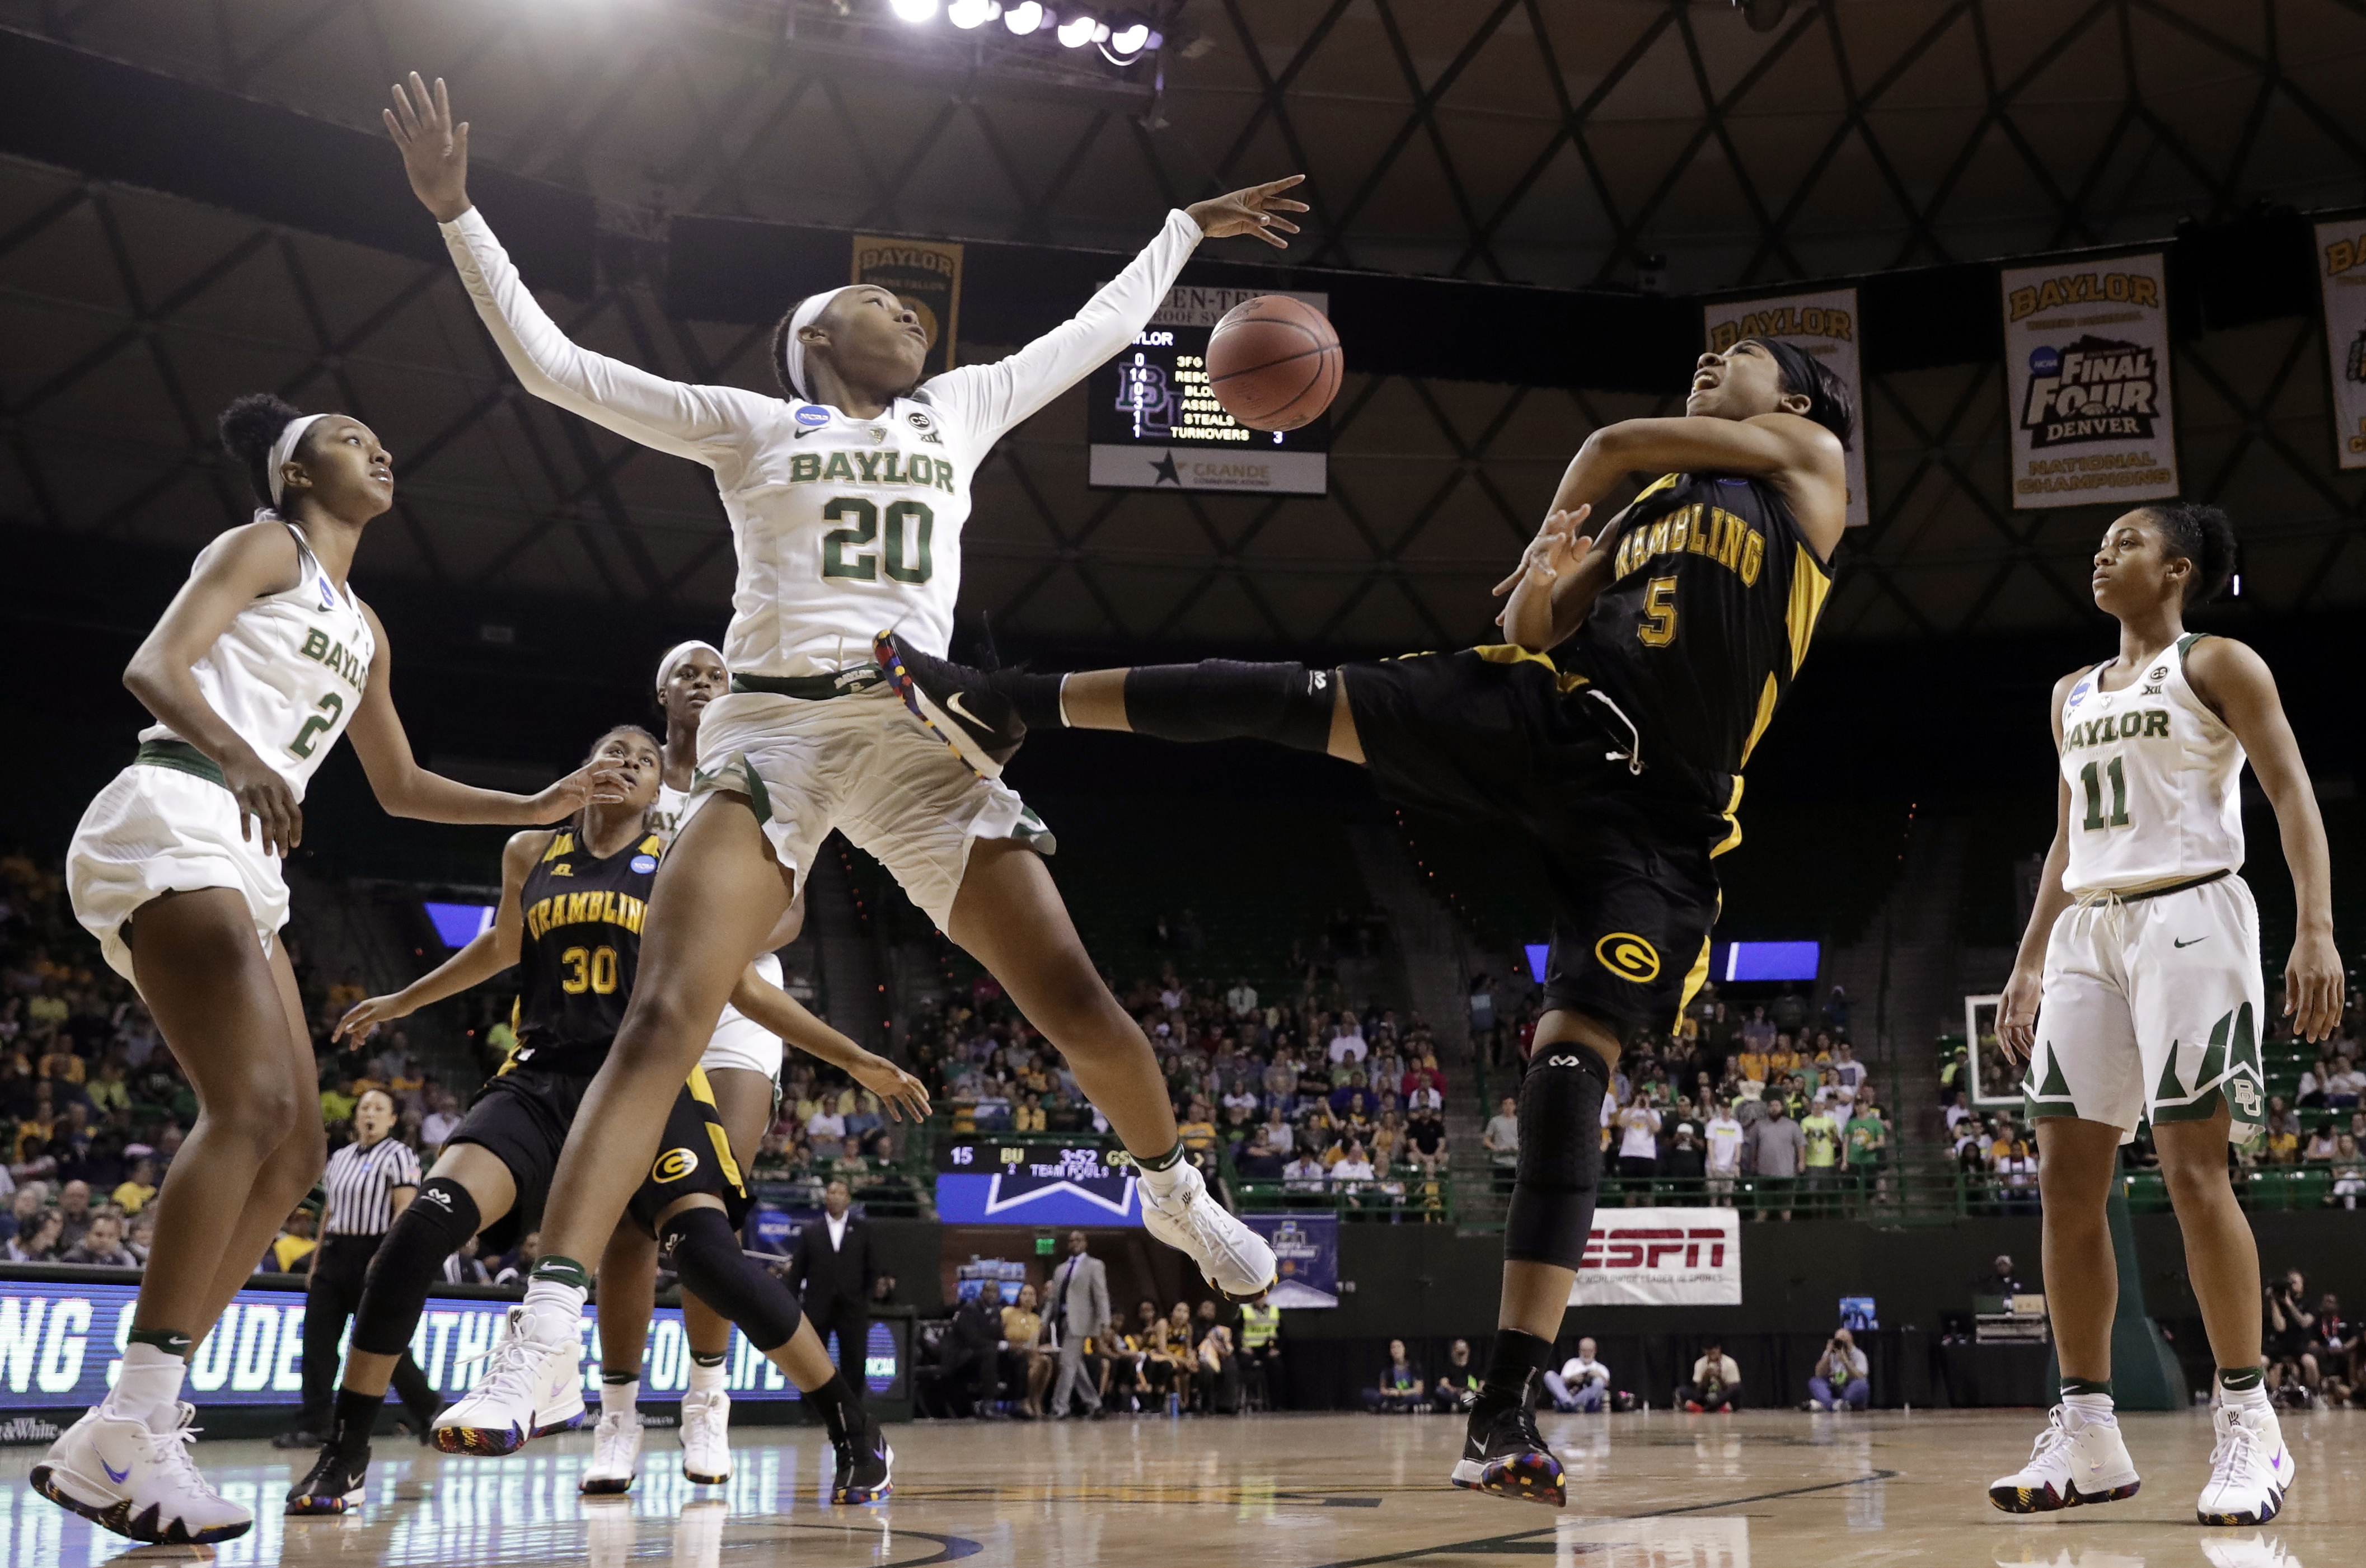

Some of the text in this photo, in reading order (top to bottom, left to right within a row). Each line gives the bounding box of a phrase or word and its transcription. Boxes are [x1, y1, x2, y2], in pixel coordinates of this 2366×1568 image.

[861, 248, 953, 278] BAYLOR
[1160, 288, 1267, 310] EN-TE
[2009, 273, 2158, 322] BAYLOR
[1132, 331, 1173, 346] YLOR
[1711, 307, 1852, 355] BAYLOR
[1130, 368, 1209, 383] 14 REBO
[2062, 353, 2151, 384] FINAL
[1184, 385, 1216, 397] BLO
[2026, 378, 2152, 425] FOUR
[1181, 400, 1226, 411] ASSIS
[911, 415, 930, 426] CS
[1184, 414, 1235, 426] STEALS
[2046, 417, 2140, 441] DENVER
[1170, 427, 1249, 441] TURNOVERS
[1273, 431, 1283, 444] 3
[790, 450, 955, 495] BAYLOR
[1193, 463, 1270, 478] GRANDE
[2029, 451, 2157, 476] NATIONAL
[2016, 468, 2171, 494] CHAMPIONS
[822, 496, 934, 586] 20
[1615, 503, 1765, 588] RAMBLING
[1637, 575, 1678, 647] 5
[297, 624, 368, 698] BAYLO
[2152, 668, 2167, 678] CS
[2140, 683, 2163, 696] XII
[287, 691, 344, 761] 2
[2081, 754, 2132, 833] 11
[527, 890, 648, 942] GRAMBLIN
[562, 945, 617, 995] 30
[2233, 1078, 2261, 1116] BU
[950, 1146, 973, 1165] 15
[1001, 1147, 1024, 1164] BU
[1029, 1164, 1065, 1177] TEAM
[1580, 1228, 1725, 1268] ESPN
